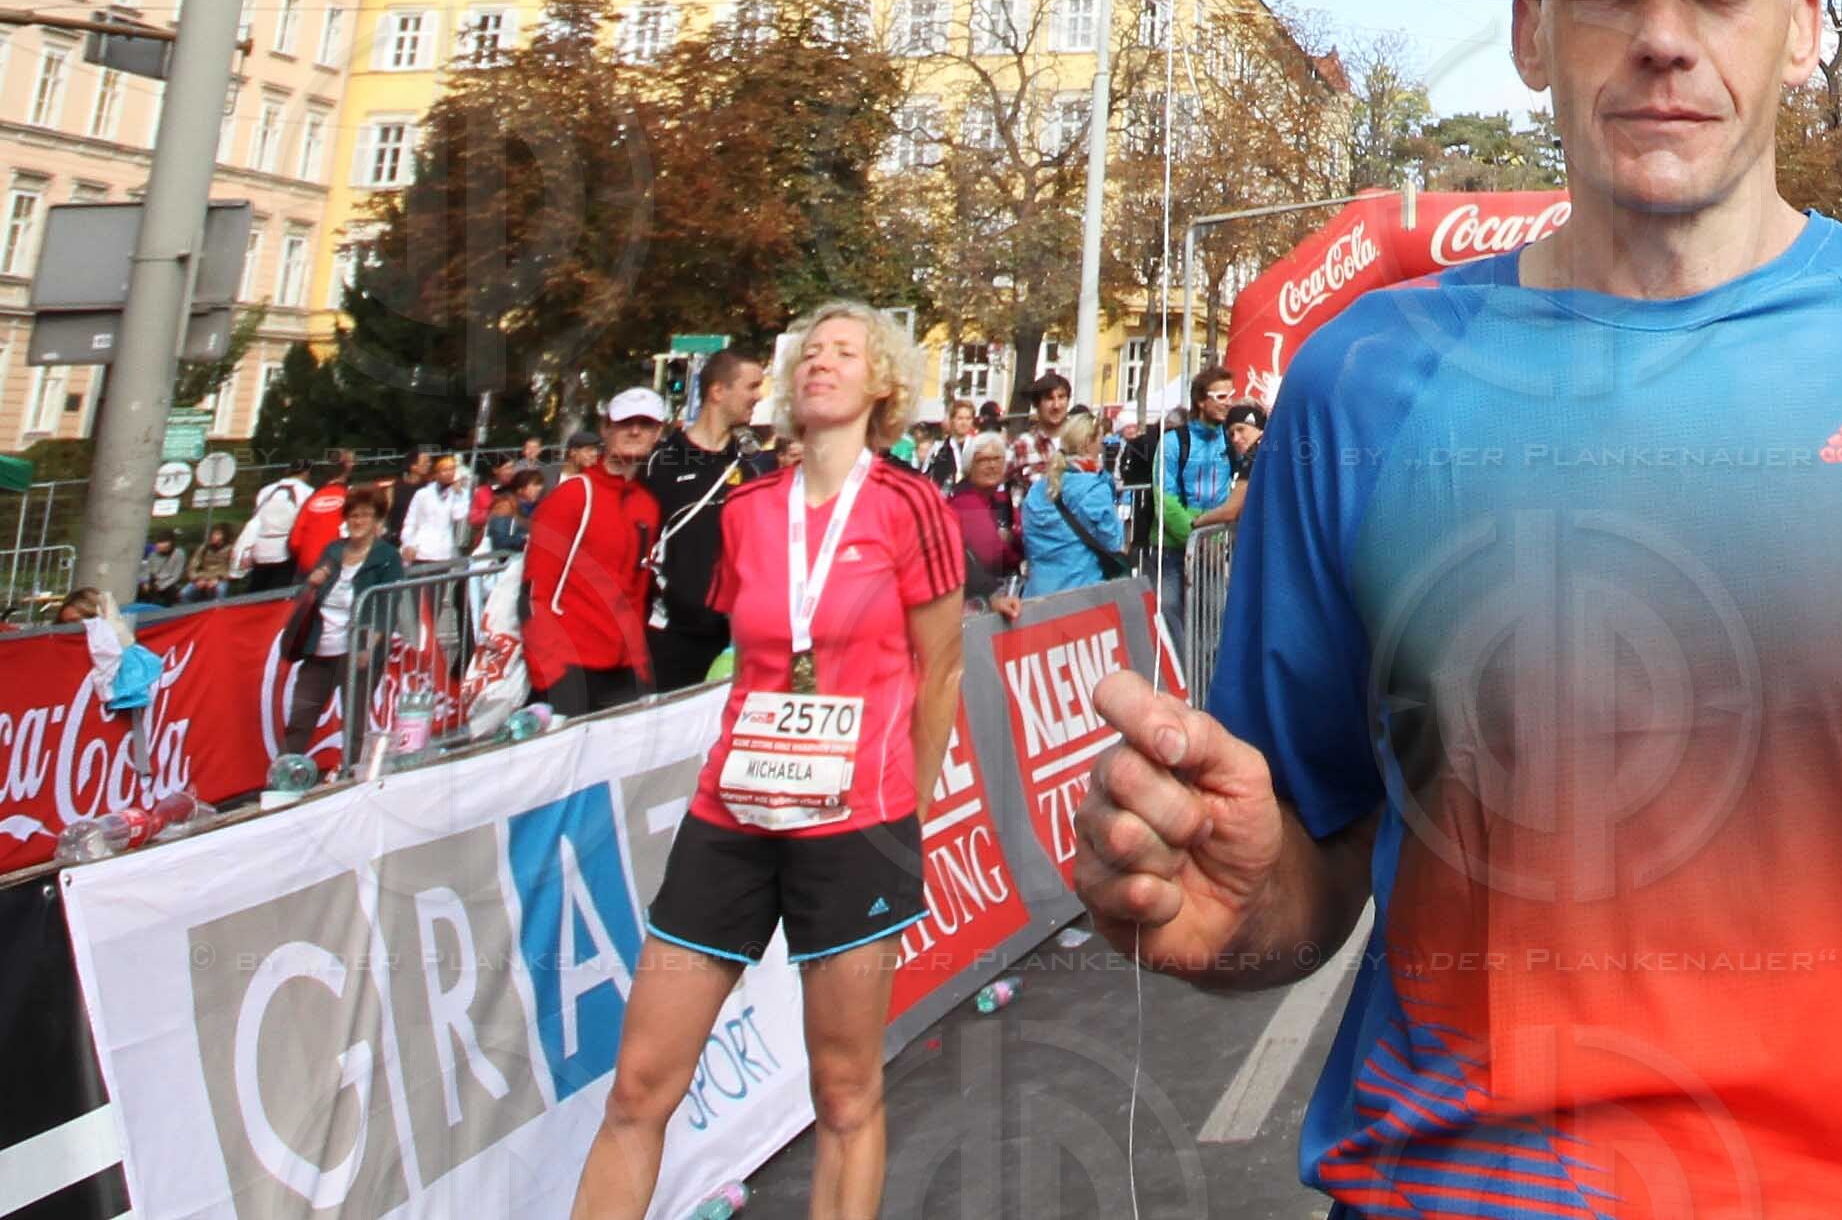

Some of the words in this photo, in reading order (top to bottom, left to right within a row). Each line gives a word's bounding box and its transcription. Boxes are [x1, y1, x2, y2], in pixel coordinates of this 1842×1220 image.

[1430, 201, 1572, 266] Coca-C
[1278, 220, 1381, 326] Coca-Cola
[776, 701, 856, 735] 2570
[746, 759, 813, 781] MICHAELA
[233, 795, 691, 1210] GRA
